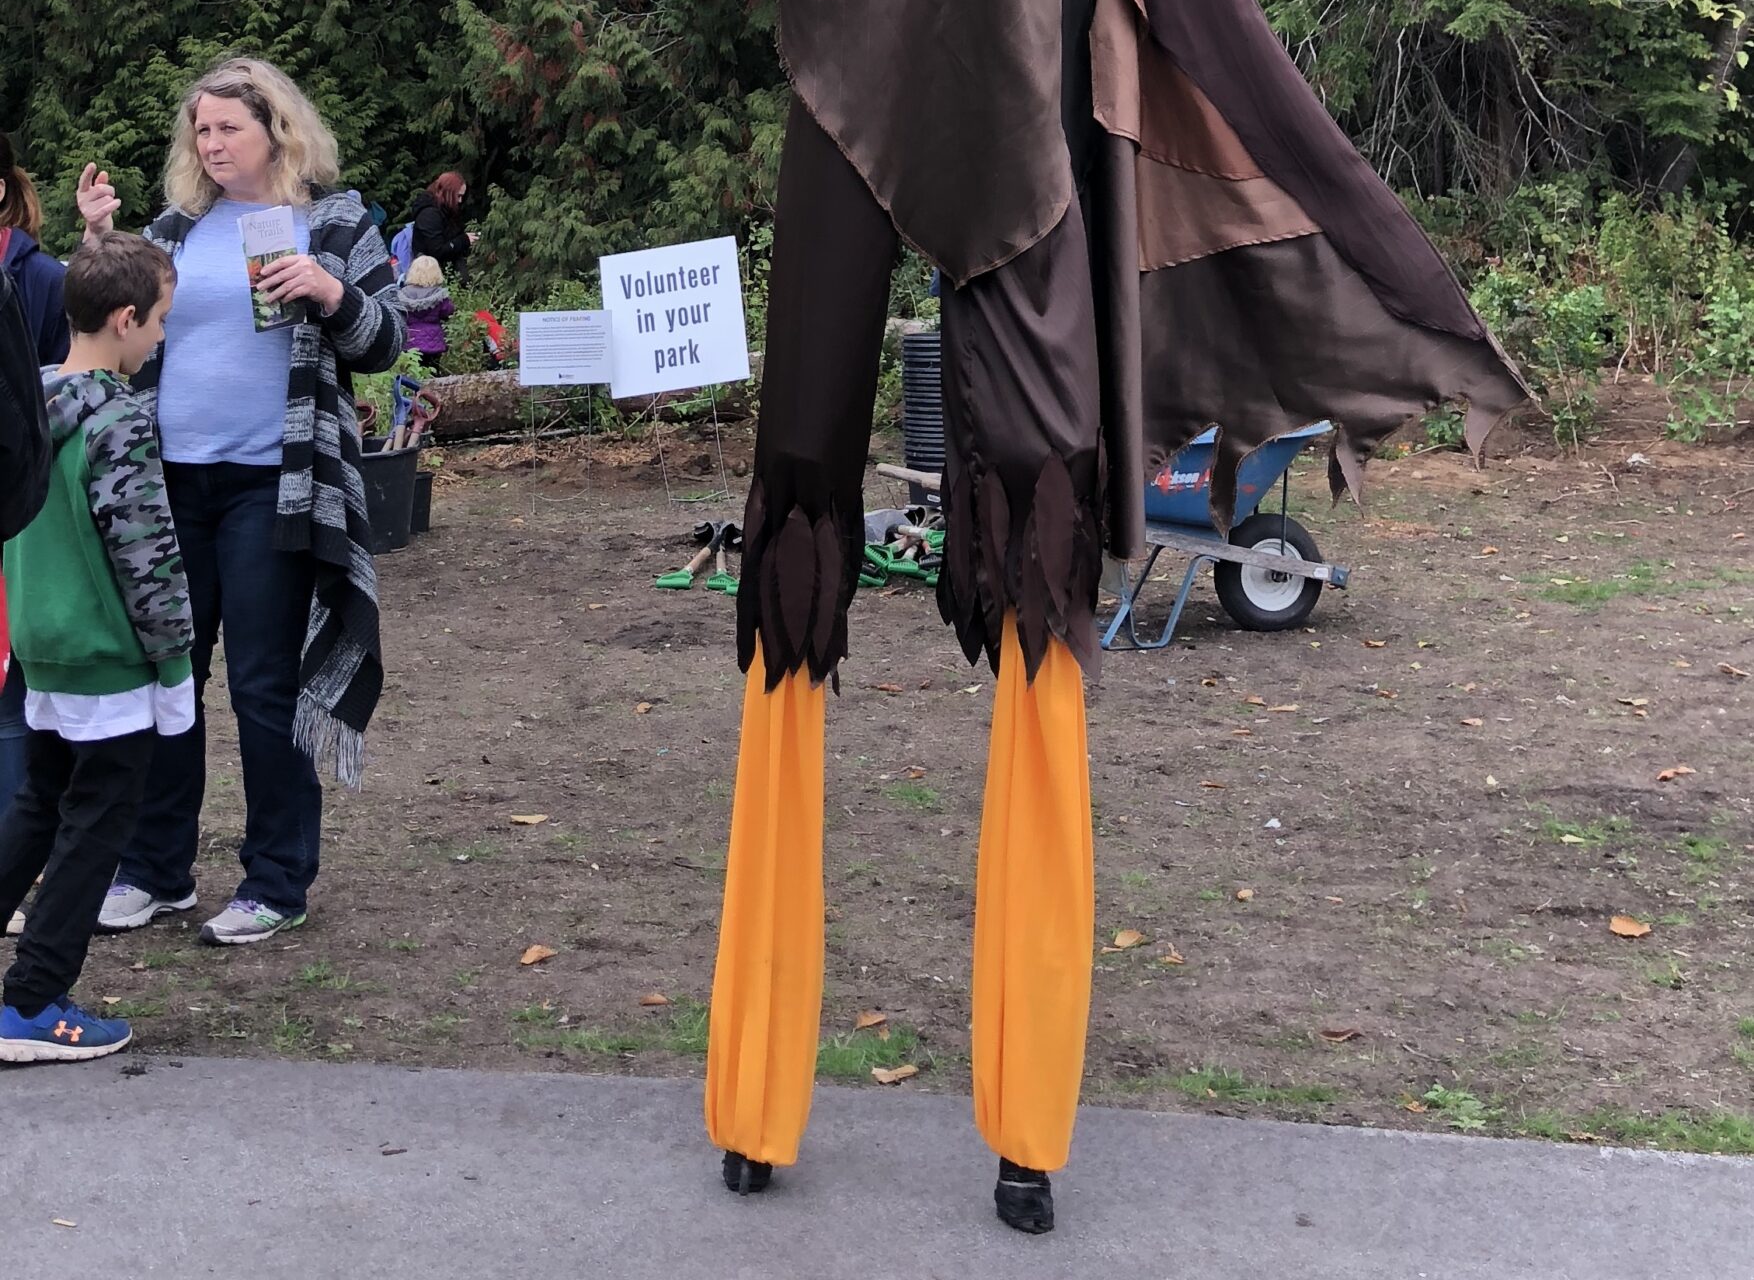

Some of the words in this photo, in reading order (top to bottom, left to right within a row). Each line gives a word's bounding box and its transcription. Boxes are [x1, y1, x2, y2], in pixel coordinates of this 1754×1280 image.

[248, 220, 281, 231] Nature
[258, 225, 284, 239] Trails
[619, 264, 720, 300] Volunteer
[636, 308, 656, 334] in
[665, 302, 711, 333] your
[654, 338, 701, 374] park
